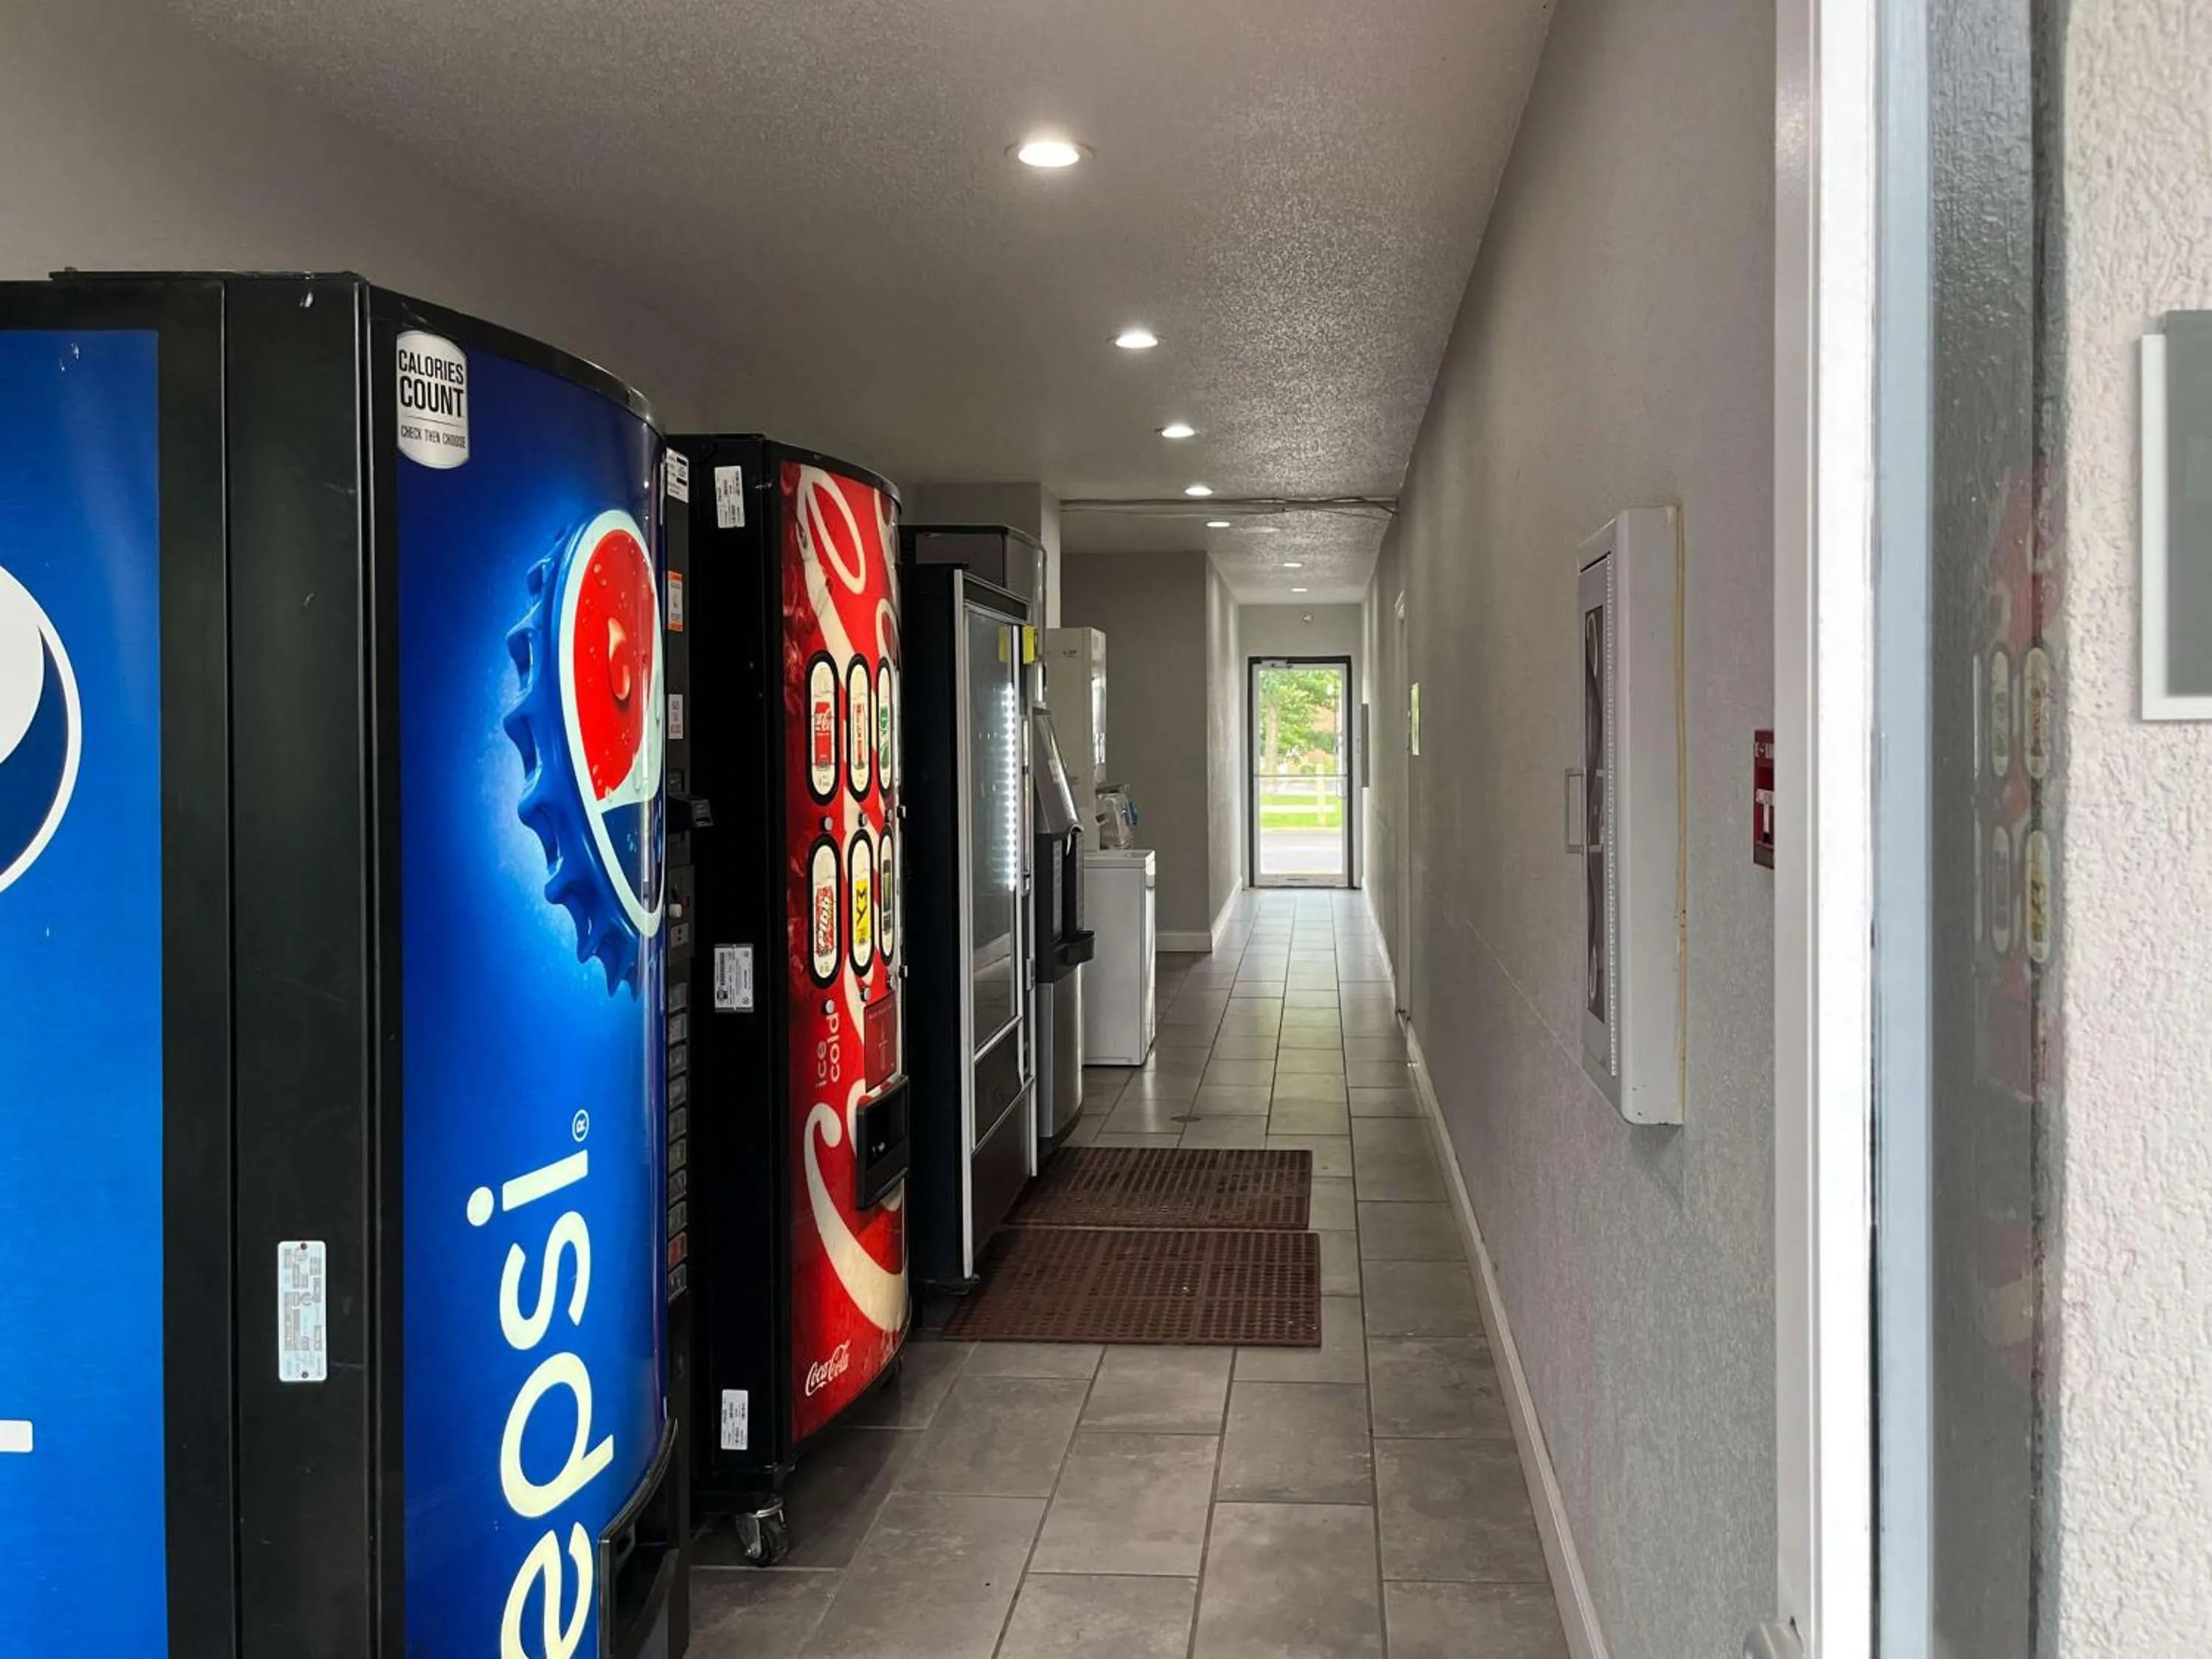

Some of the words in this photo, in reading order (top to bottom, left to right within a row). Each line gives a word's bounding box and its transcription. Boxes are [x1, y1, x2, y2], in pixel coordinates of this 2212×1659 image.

[399, 349, 464, 385] CALORIES
[400, 376, 465, 417] COUNT
[401, 425, 422, 440] CHECK
[425, 429, 440, 443] THEN
[442, 432, 466, 449] CHOOSE
[815, 1040, 827, 1088] ice
[826, 1012, 840, 1083] cold
[467, 1150, 614, 1659] epsi
